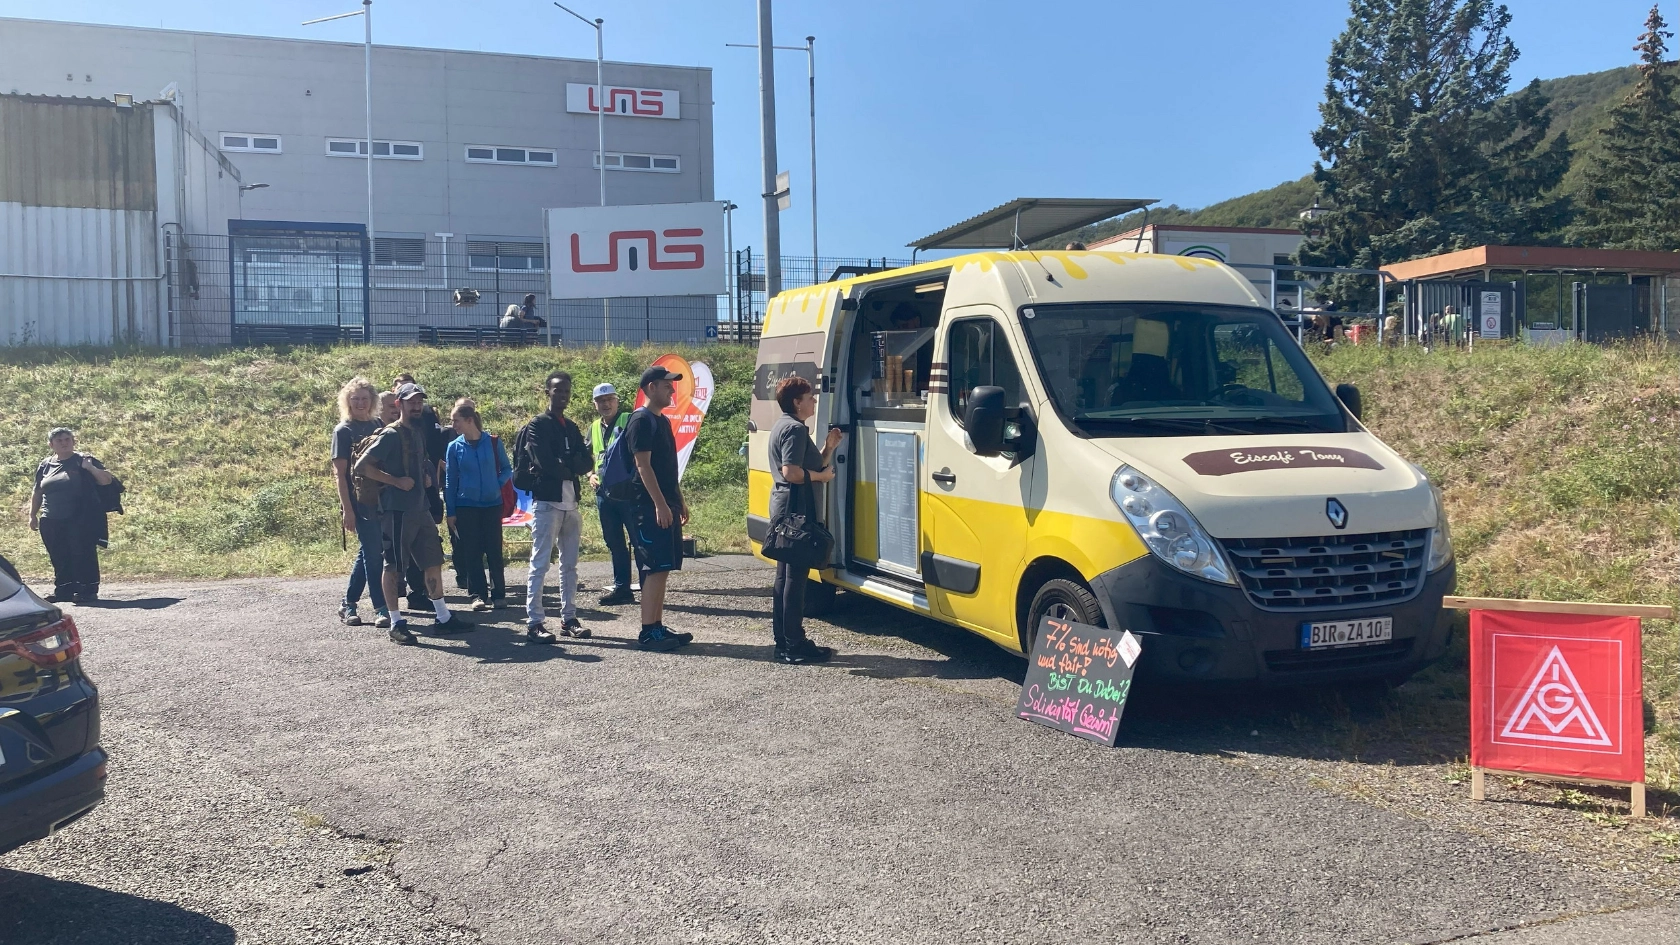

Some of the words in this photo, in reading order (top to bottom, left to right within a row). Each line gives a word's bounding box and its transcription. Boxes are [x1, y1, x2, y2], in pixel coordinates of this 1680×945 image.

[1229, 450, 1295, 465] Eiscafé
[1299, 449, 1345, 463] Tony
[1312, 624, 1337, 644] BIR
[1347, 622, 1363, 641] ZA
[1366, 621, 1382, 639] 10
[1046, 620, 1073, 651] 7%
[1092, 637, 1118, 668] nötig
[1037, 654, 1057, 670] und
[1077, 678, 1093, 695] Du
